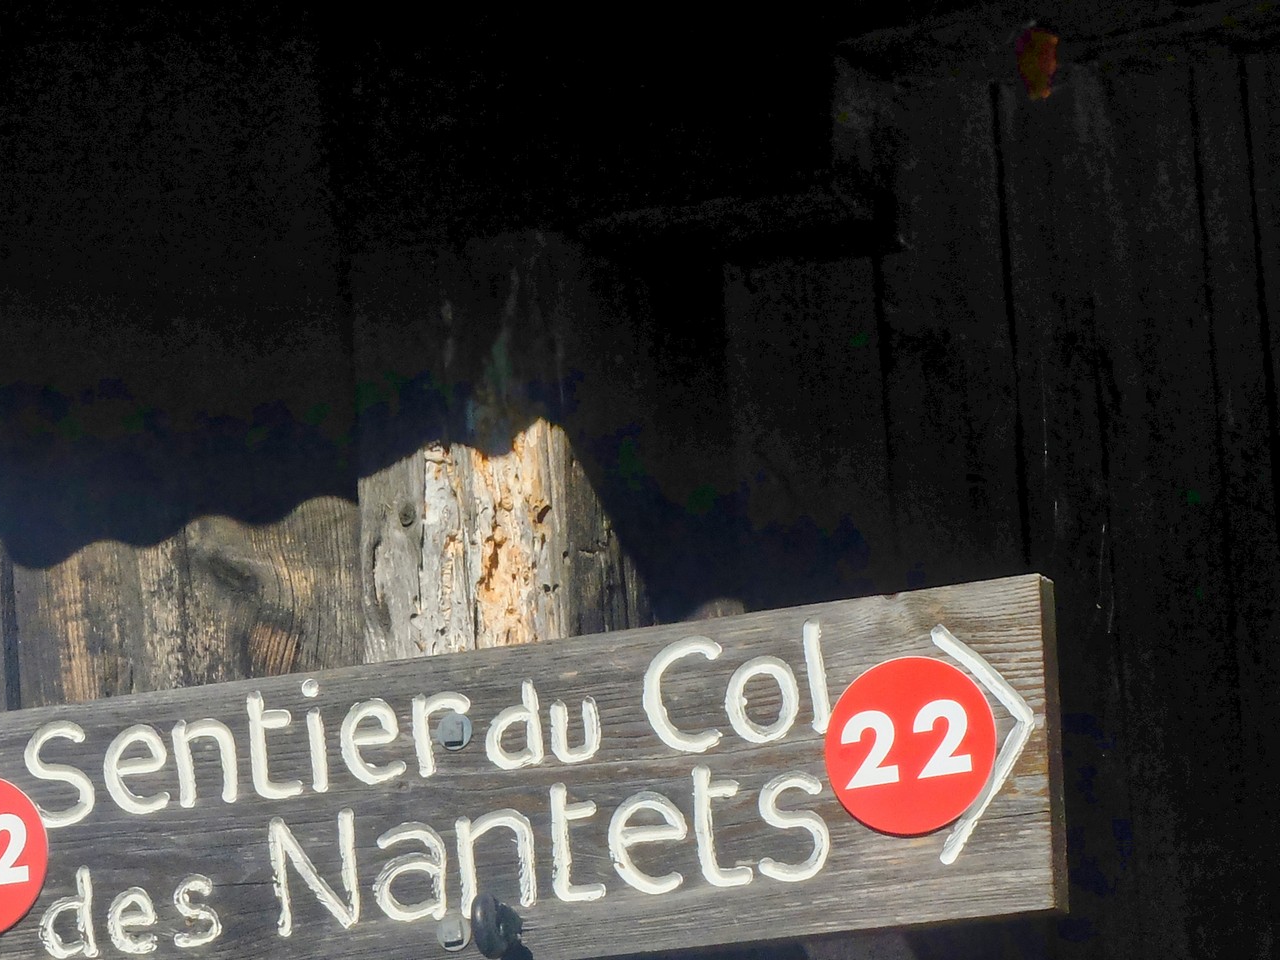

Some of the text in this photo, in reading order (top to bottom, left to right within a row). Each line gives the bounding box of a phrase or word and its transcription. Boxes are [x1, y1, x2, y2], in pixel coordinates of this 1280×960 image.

[24, 617, 831, 828] Sentier du Col
[841, 699, 973, 790] 22
[39, 765, 830, 959] des Nantets
